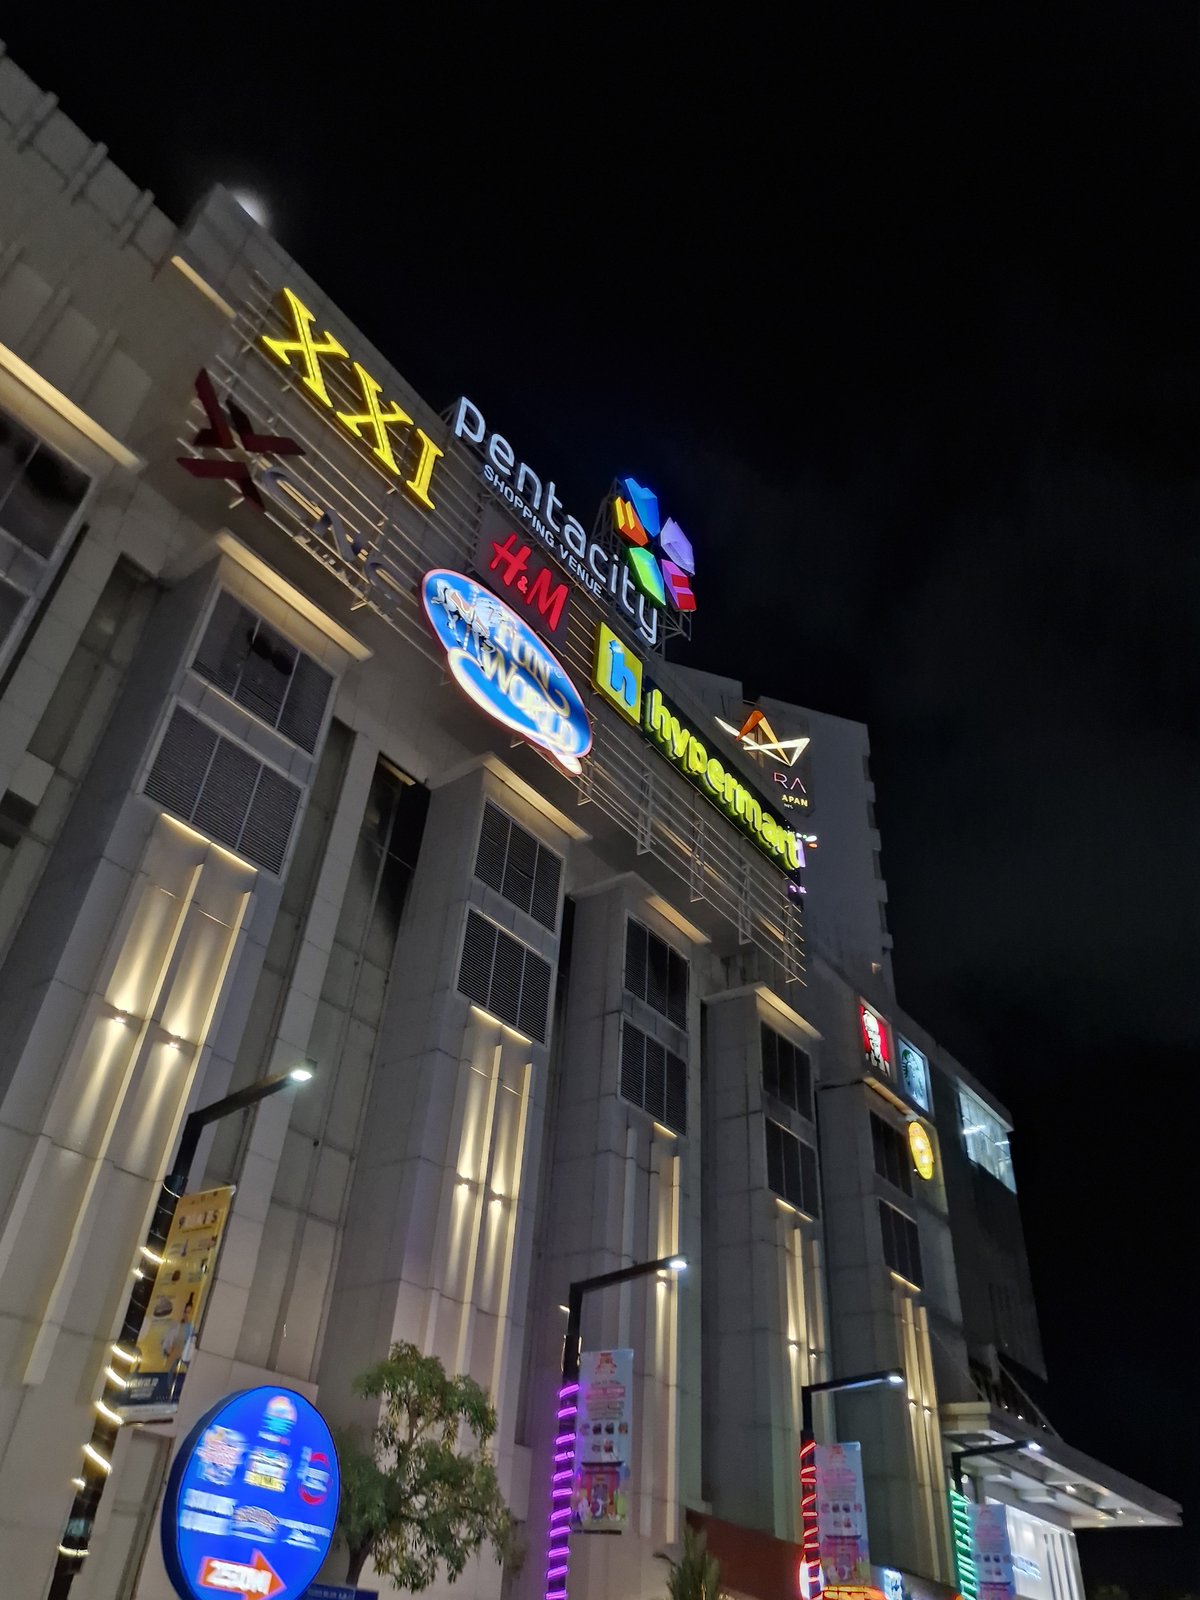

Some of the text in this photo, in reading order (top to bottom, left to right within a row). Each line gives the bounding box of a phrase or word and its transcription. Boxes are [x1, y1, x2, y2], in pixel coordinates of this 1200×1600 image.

[261, 287, 445, 510] XXI
[454, 396, 658, 645] pentacity
[483, 463, 603, 598] SHOPPING VENUE
[489, 533, 569, 632] H&M
[648, 688, 801, 870] hypermart
